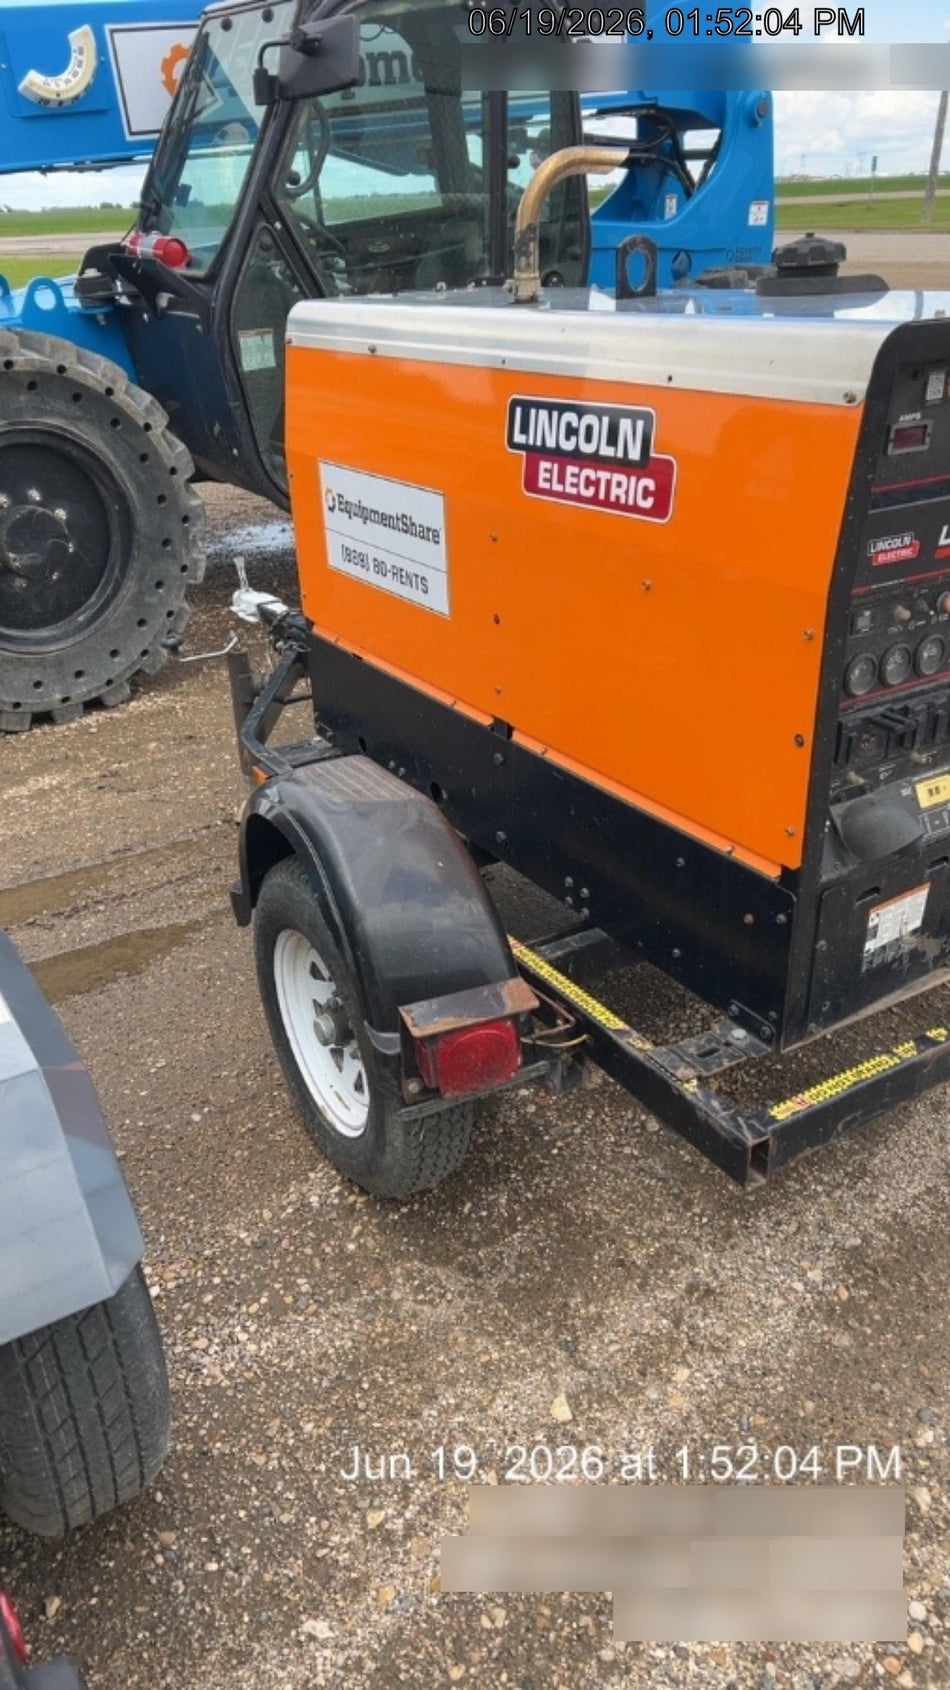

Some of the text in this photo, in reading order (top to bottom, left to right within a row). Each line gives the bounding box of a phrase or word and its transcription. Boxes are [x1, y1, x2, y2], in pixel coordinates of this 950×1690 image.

[513, 406, 645, 461] LINCOLN
[538, 461, 656, 509] ELECTRIC
[337, 493, 441, 545] EquipmentShare
[870, 535, 912, 553] LINCOLN
[878, 547, 914, 563] ELECTRIC
